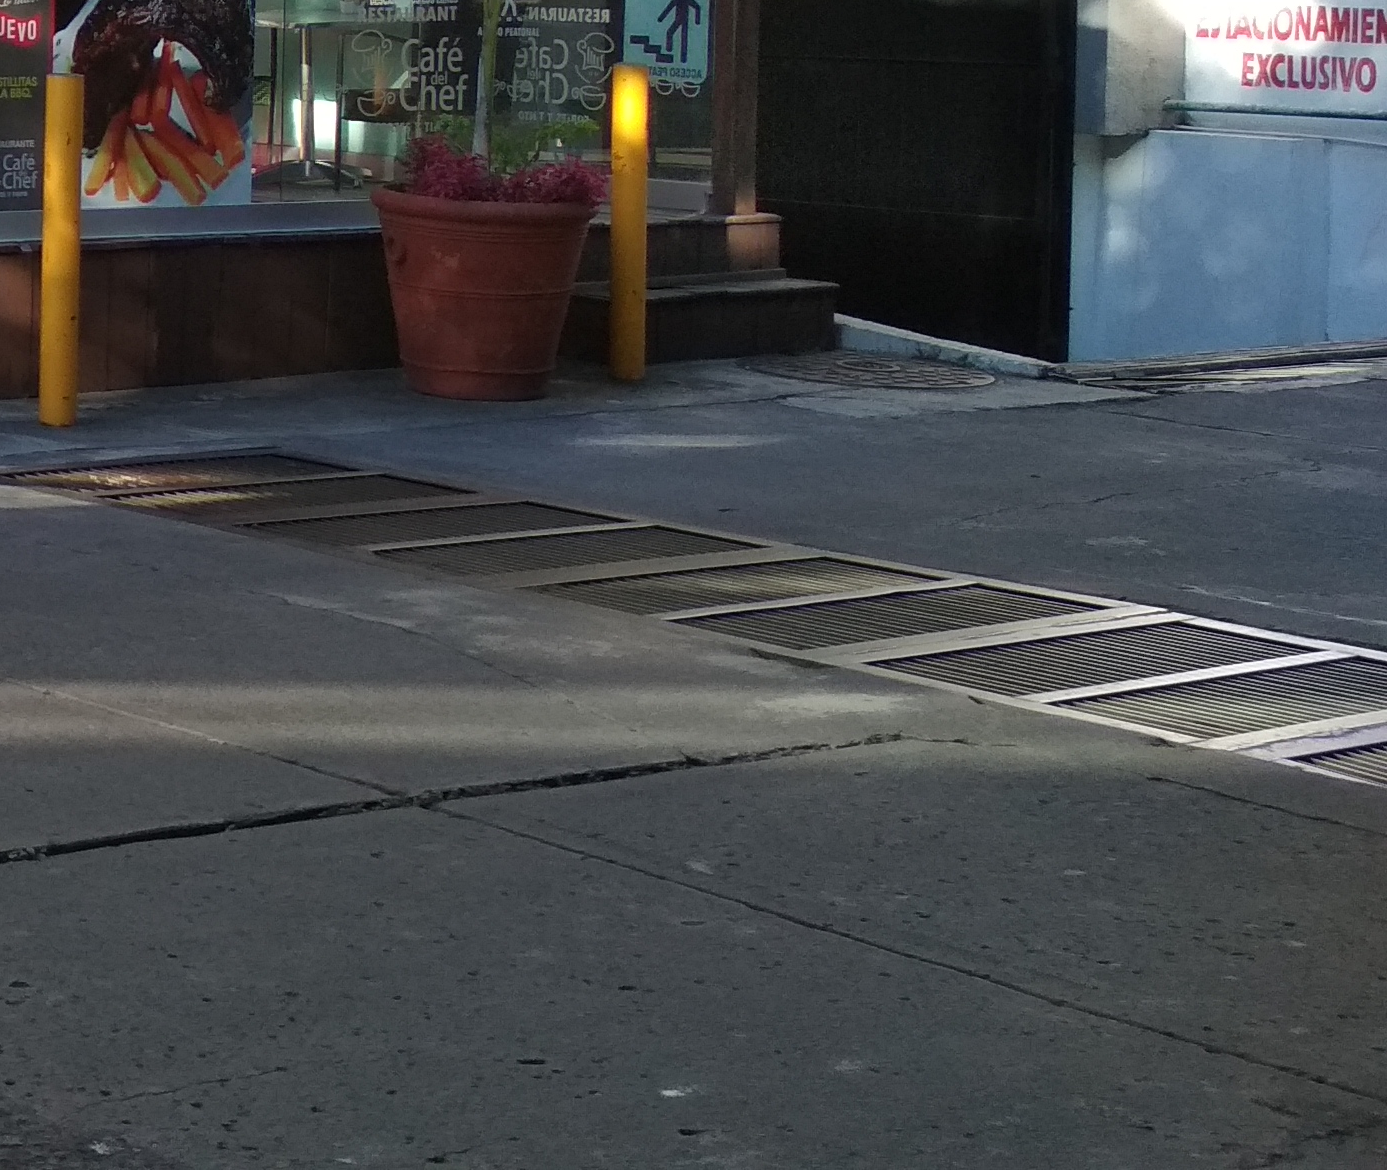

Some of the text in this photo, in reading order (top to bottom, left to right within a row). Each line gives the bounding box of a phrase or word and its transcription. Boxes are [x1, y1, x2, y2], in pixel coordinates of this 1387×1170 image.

[401, 37, 464, 72] Café
[430, 71, 447, 85] del
[1241, 53, 1378, 94] EXCLUSIVO
[400, 74, 469, 111] Chef
[3, 153, 35, 170] Café
[3, 171, 38, 189] Chef
